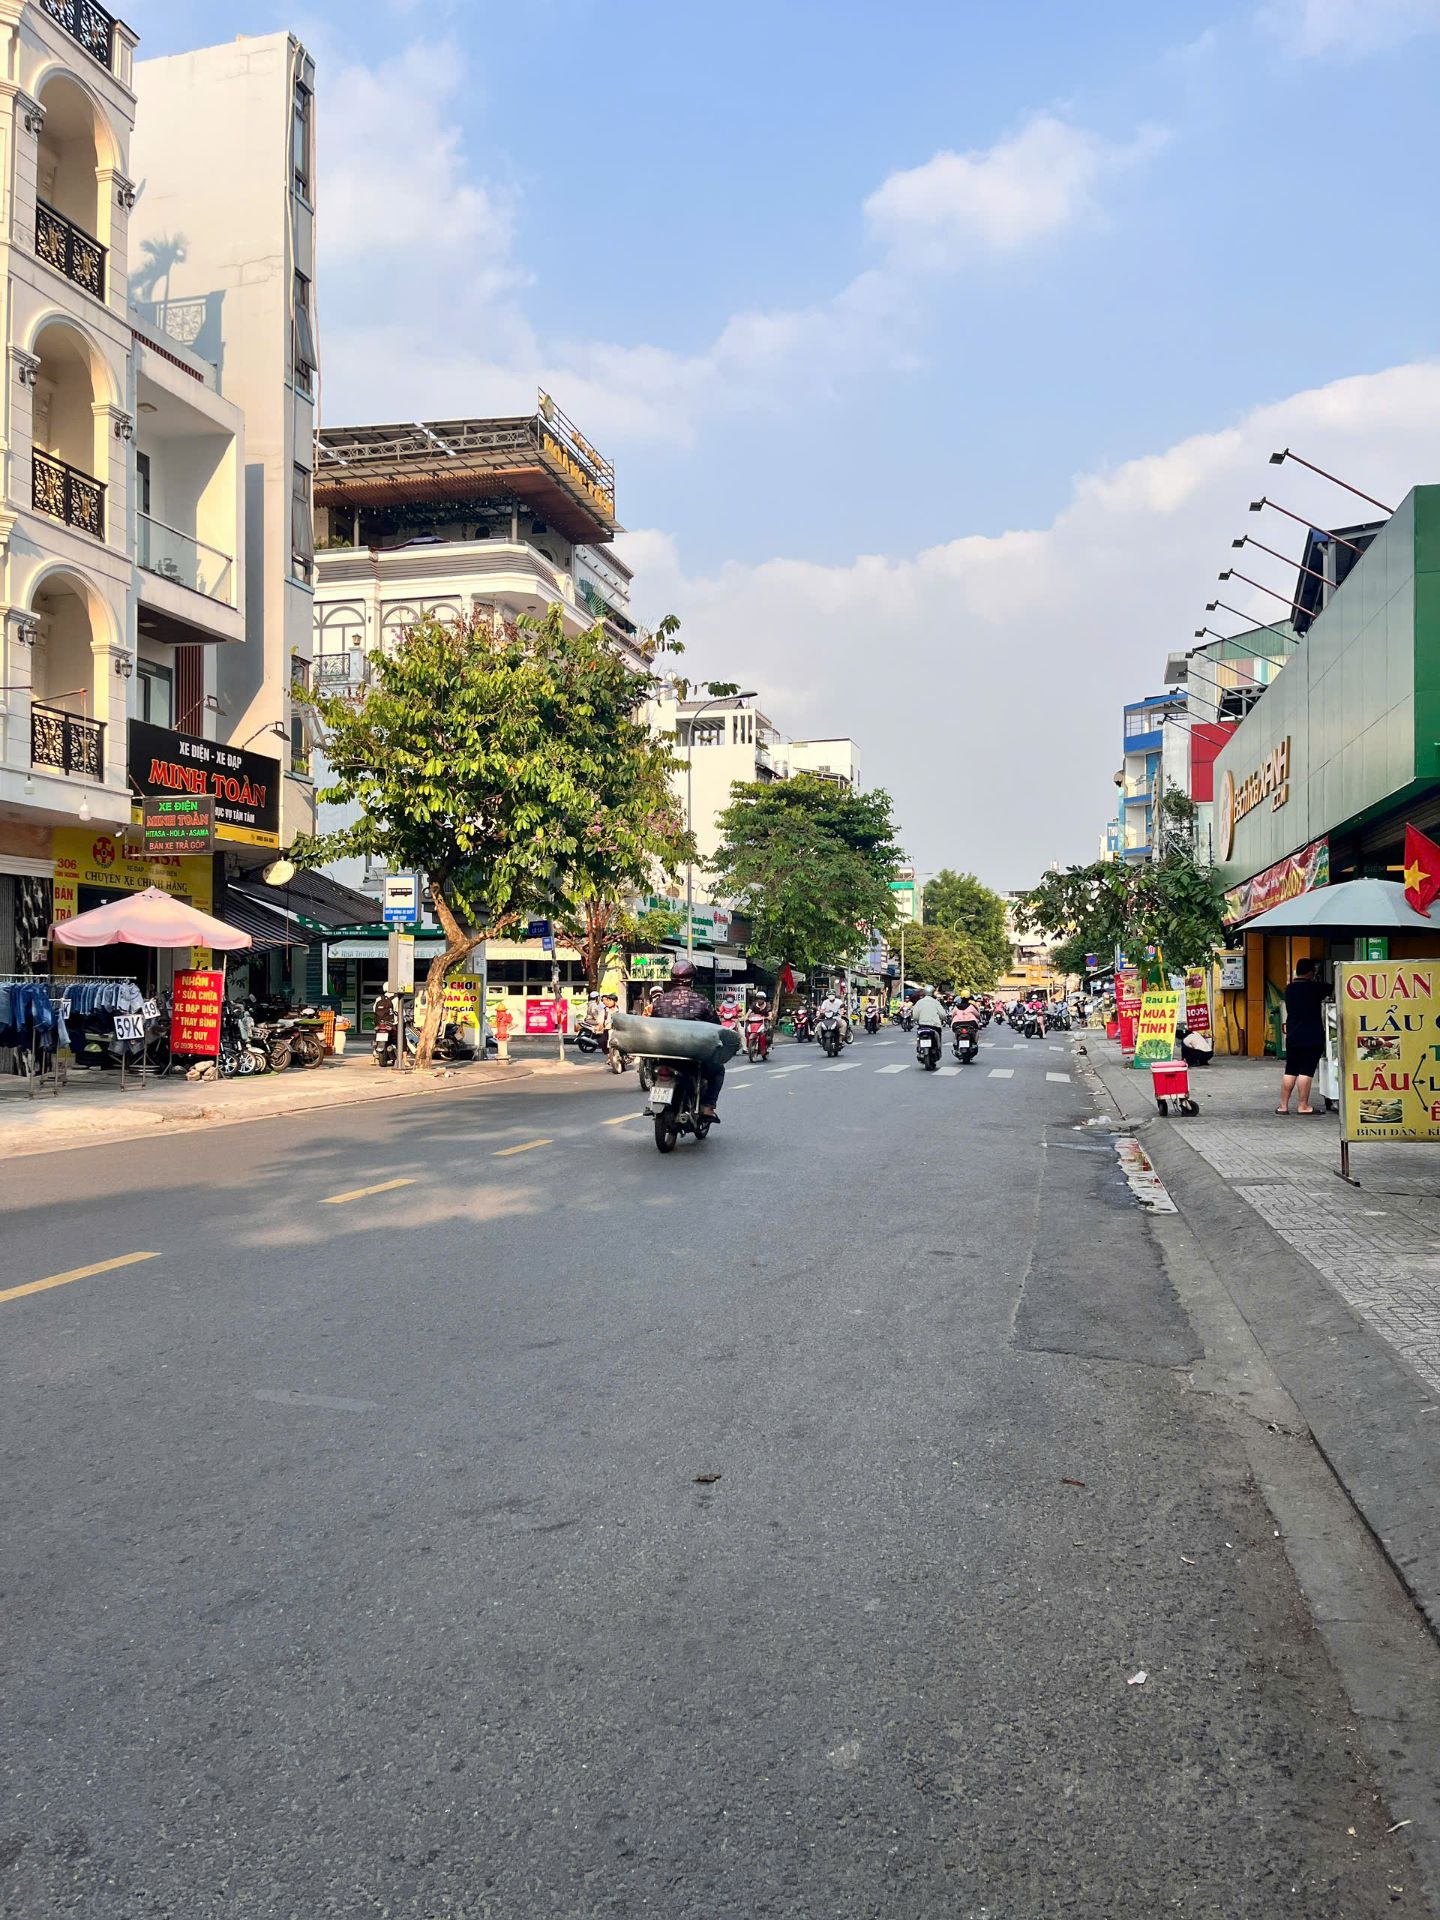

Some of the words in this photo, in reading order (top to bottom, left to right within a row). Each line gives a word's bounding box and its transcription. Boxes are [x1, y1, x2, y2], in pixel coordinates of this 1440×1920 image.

[179, 741, 190, 756] XE
[191, 744, 210, 763] ĐIỆN
[216, 751, 226, 766] XE
[227, 754, 242, 771] ĐẠP
[148, 759, 208, 795] MINH
[211, 774, 267, 808] TOÀN
[159, 803, 172, 812] XE
[174, 800, 198, 812] ĐIỆN
[146, 815, 176, 827] MINH
[145, 830, 166, 838] HITASA
[169, 829, 186, 837] HOLA
[188, 828, 209, 837] ASAMA
[149, 841, 164, 851] BÁN
[165, 841, 174, 850] XE
[175, 839, 189, 850] TRẢ
[190, 840, 206, 850] GÓP
[57, 857, 78, 869] 306
[55, 886, 73, 901] BÁN
[55, 905, 72, 920] TRẢ
[450, 981, 476, 990] CHƠI
[1346, 968, 1432, 1001] QUÁN
[1145, 996, 1164, 1005] Rau
[1165, 995, 1178, 1004] Lá
[174, 1003, 184, 1013] XE
[1143, 1009, 1167, 1019] MUA
[1169, 1009, 1176, 1019] 2
[180, 1017, 198, 1027] THAY
[1359, 1004, 1424, 1032] LẨU
[117, 1018, 142, 1039] 59K
[1140, 1020, 1167, 1034] TÍNH
[1170, 1023, 1175, 1033] 1
[193, 1031, 208, 1041] QUY
[1352, 1062, 1410, 1091] LẨU
[1357, 1126, 1387, 1136] BÌNH
